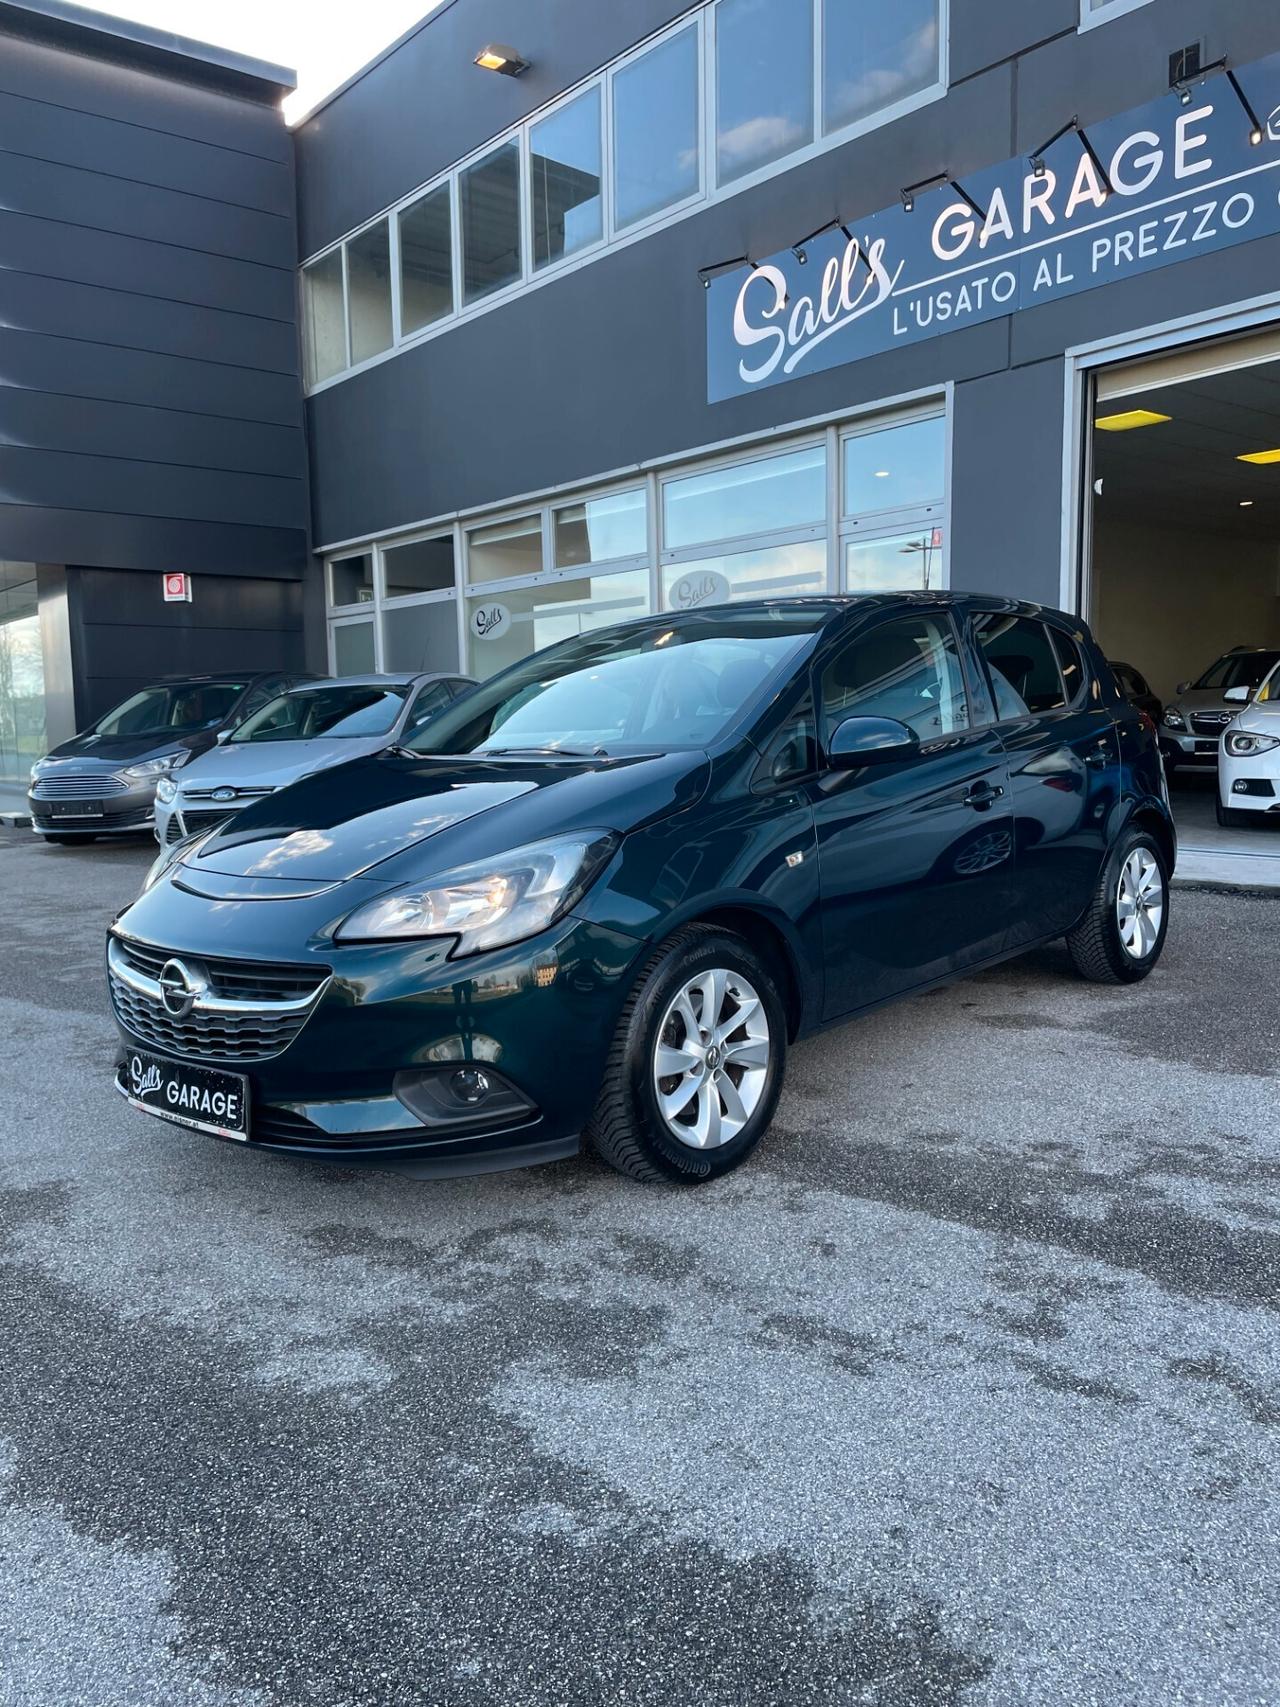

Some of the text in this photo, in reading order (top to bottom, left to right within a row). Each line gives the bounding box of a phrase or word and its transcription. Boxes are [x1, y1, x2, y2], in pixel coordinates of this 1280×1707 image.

[931, 104, 1214, 261] GARAGE
[893, 192, 1255, 336] L'USATO AL PREZZO
[166, 1081, 238, 1119] GARAGE
